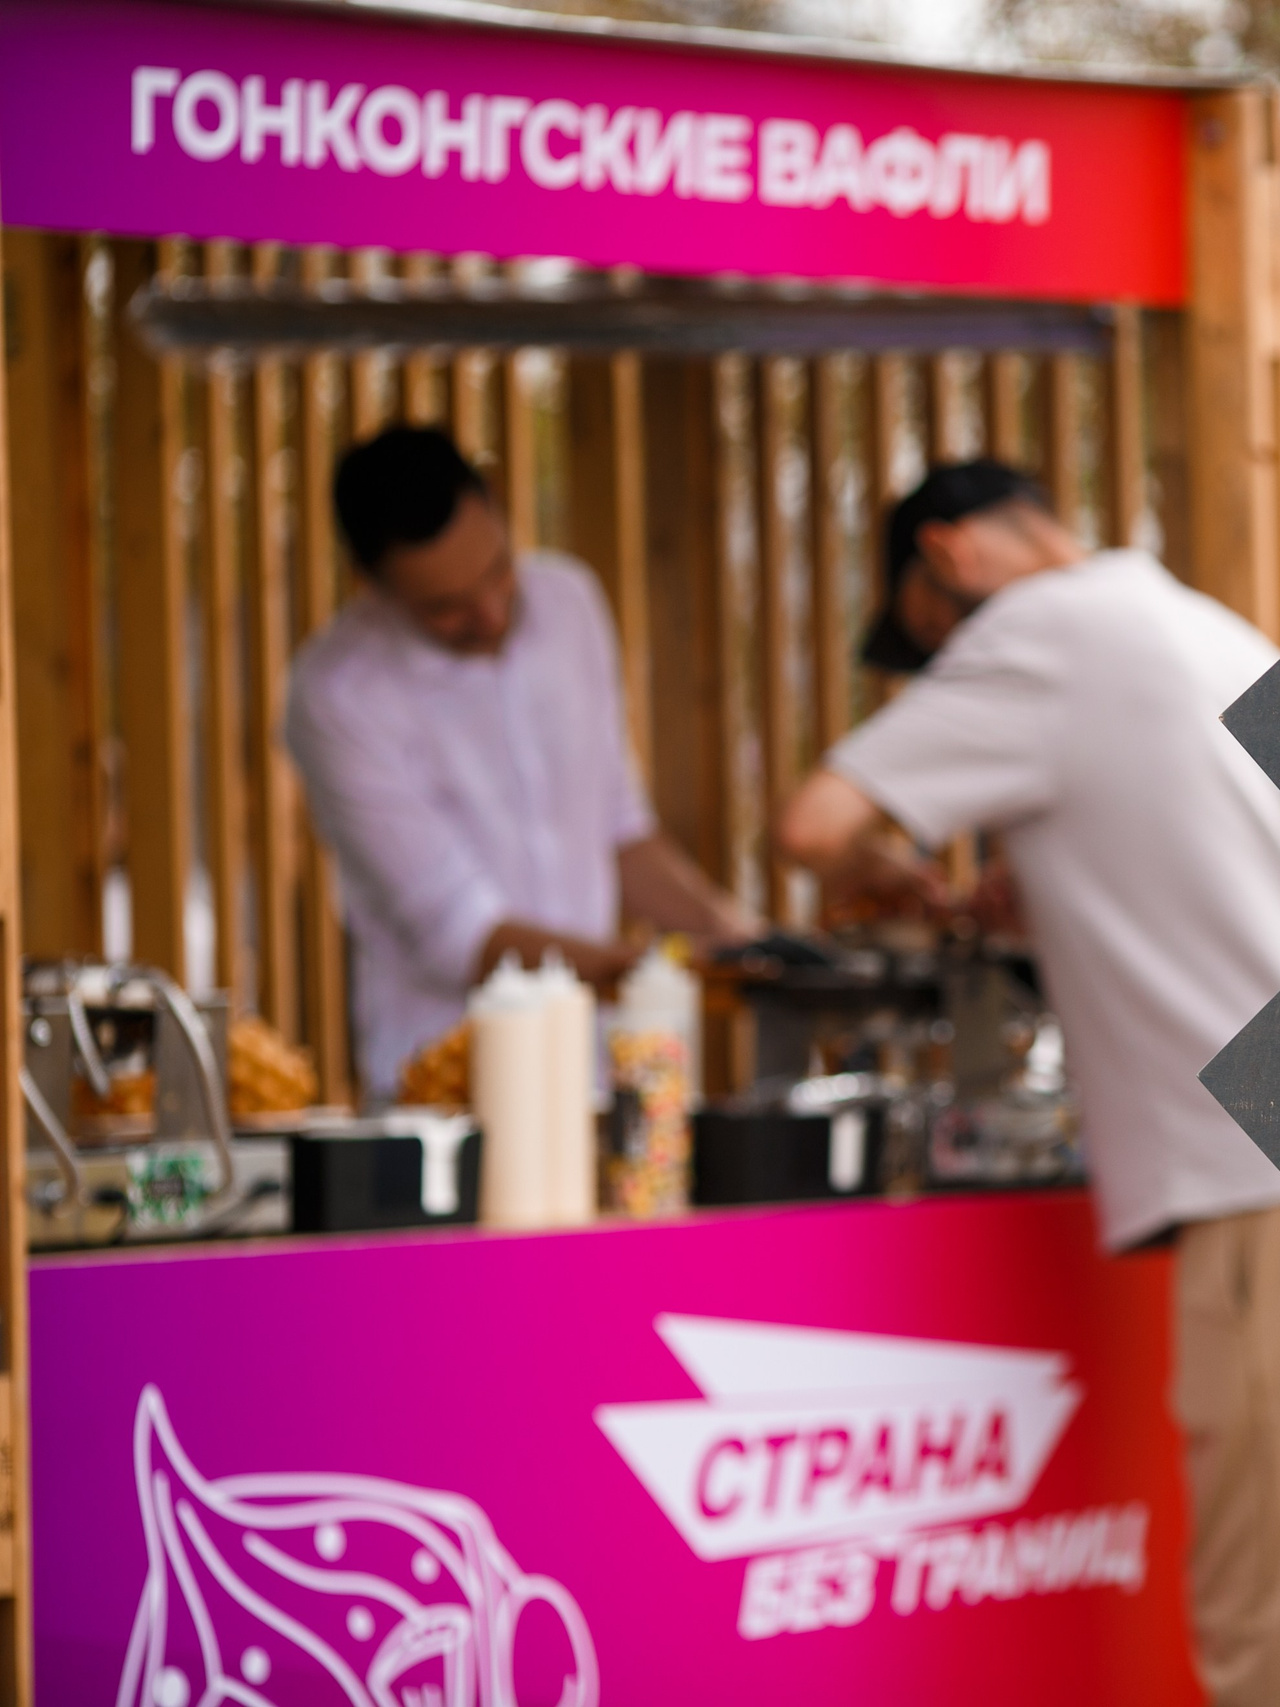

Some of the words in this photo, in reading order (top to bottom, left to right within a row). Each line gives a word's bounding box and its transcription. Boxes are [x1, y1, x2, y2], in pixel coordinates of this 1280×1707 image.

[131, 66, 754, 204] ГОНКОНГСКИЕ
[759, 118, 1051, 224] ВАФЛИ
[694, 1406, 1011, 1519] СТРАНА
[738, 1541, 877, 1641] БЕЗ
